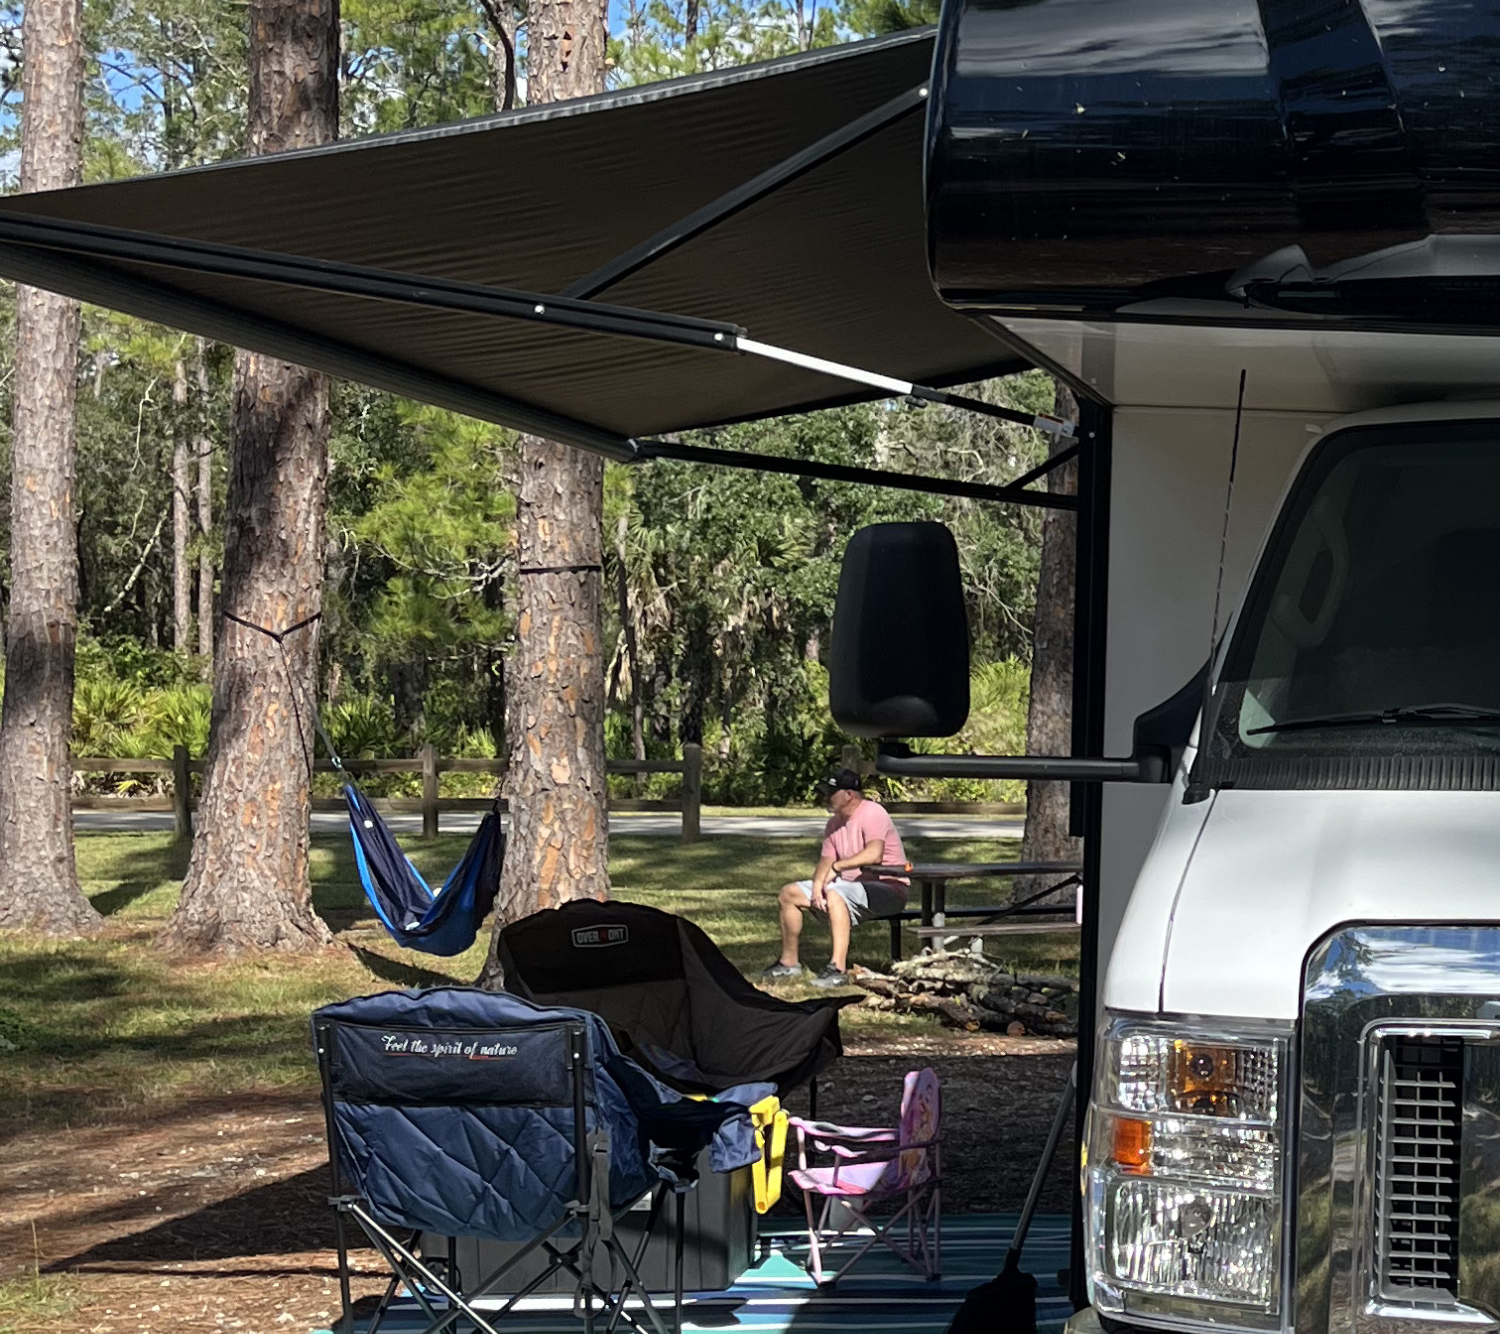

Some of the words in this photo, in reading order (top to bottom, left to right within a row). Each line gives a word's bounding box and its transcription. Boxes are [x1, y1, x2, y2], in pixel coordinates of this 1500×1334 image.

[381, 1034, 409, 1052] Feel
[409, 1039, 429, 1054] the
[430, 1040, 463, 1058] spirit
[463, 1041, 479, 1060] of
[480, 1042, 518, 1056] nature
